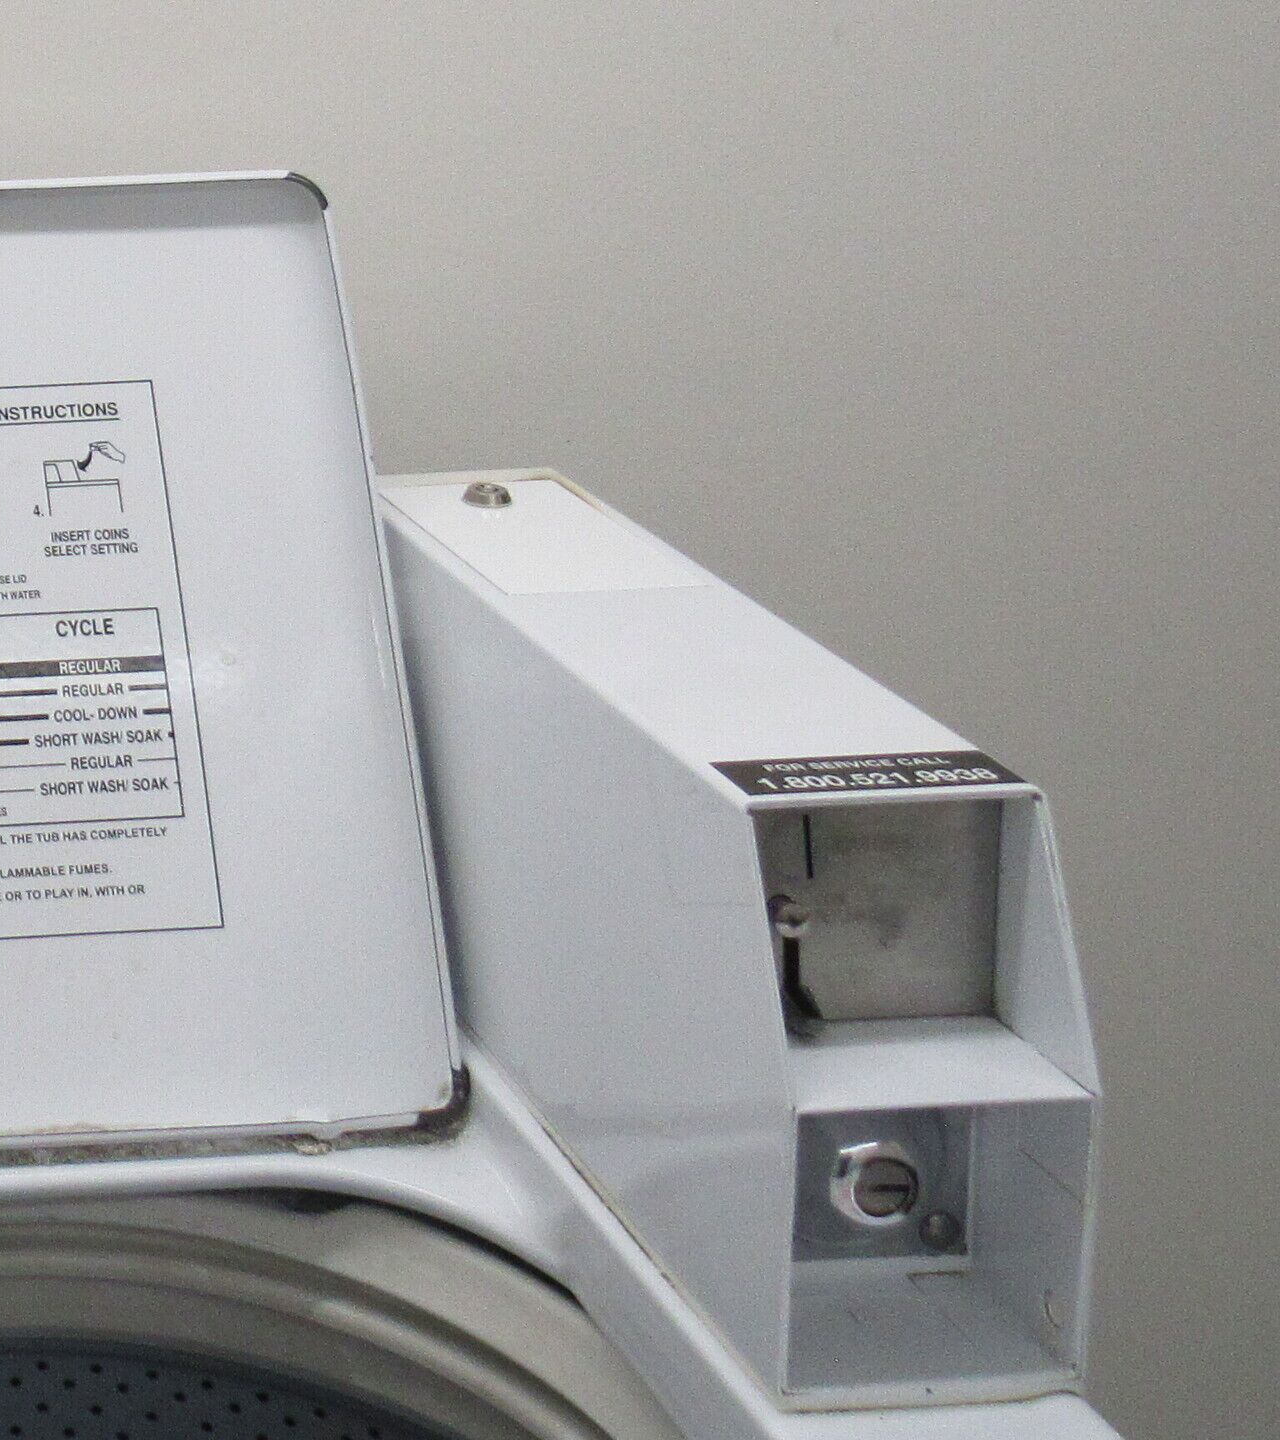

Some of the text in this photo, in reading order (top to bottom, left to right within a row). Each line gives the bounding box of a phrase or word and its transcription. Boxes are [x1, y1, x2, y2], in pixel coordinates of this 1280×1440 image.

[50, 528, 129, 542] INSERT COINS
[44, 542, 138, 557] SELECT SETTING
[56, 618, 115, 637] CYCLE
[59, 659, 121, 674] REGULAR
[62, 683, 124, 697] REGULAR
[98, 707, 138, 720] DOWN
[35, 733, 77, 747] SHORT
[127, 729, 163, 743] SOAK
[71, 755, 133, 770] REGULAR
[897, 757, 950, 766] CALL
[10, 834, 32, 844] THE
[36, 832, 59, 843] TUB
[63, 831, 87, 841] HAS
[90, 827, 167, 840] COMPLETELY
[69, 864, 112, 875] FUMES.
